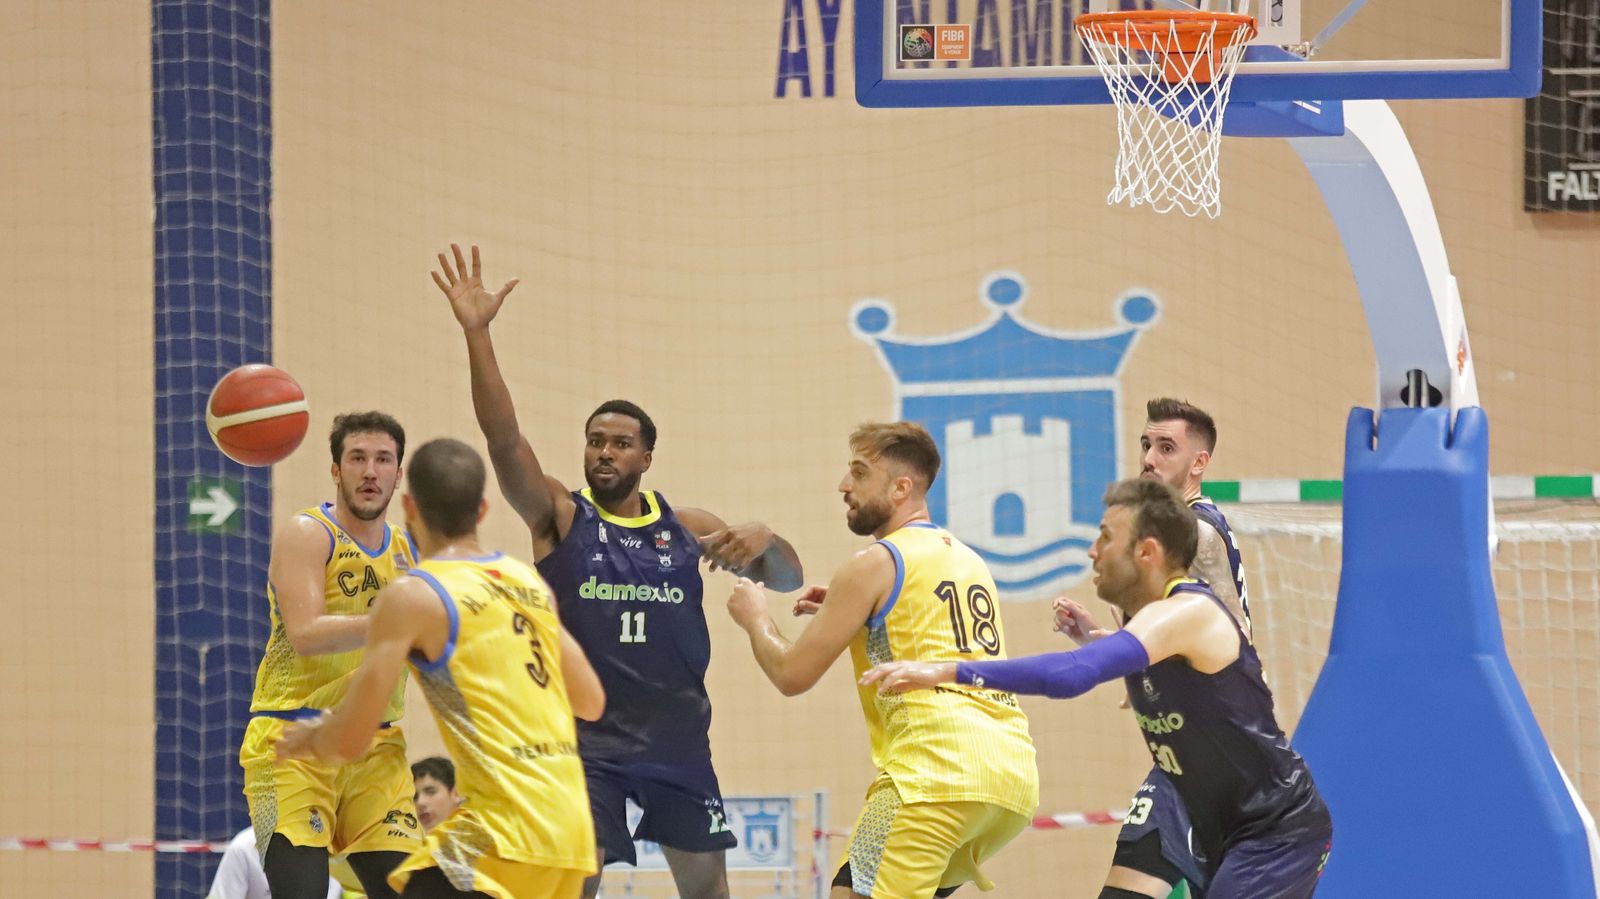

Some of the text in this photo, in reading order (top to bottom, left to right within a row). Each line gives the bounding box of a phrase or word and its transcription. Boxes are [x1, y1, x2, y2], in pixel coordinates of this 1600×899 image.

[941, 30, 965, 41] FIBA
[338, 548, 361, 560] vive
[620, 536, 643, 550] vive
[619, 611, 647, 643] 11
[934, 580, 1001, 656] 18
[512, 611, 550, 690] 3
